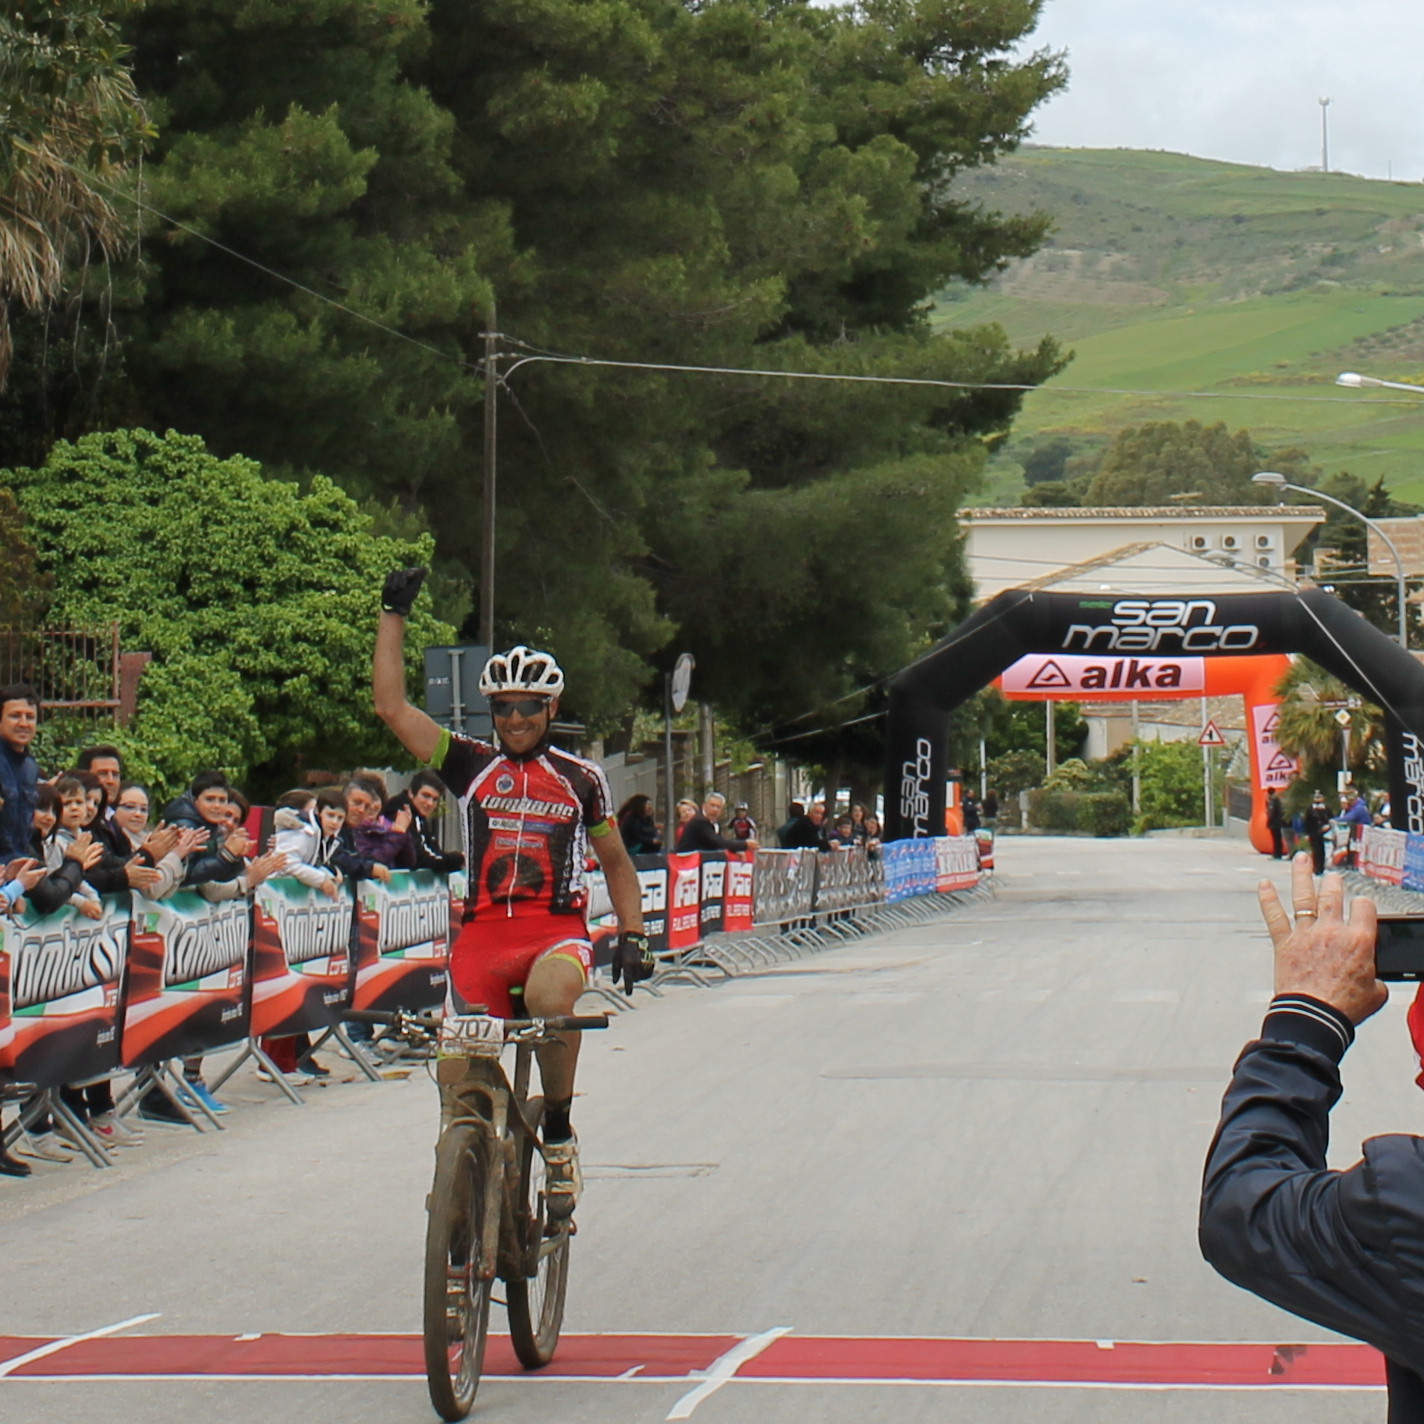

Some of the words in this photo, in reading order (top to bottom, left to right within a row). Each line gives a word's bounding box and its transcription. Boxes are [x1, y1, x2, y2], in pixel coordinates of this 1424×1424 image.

[1110, 599, 1217, 626] san
[1061, 624, 1260, 652] marco
[1079, 657, 1183, 690] alka
[900, 760, 917, 819] san
[913, 737, 932, 839] marco
[453, 1018, 493, 1039] 707
